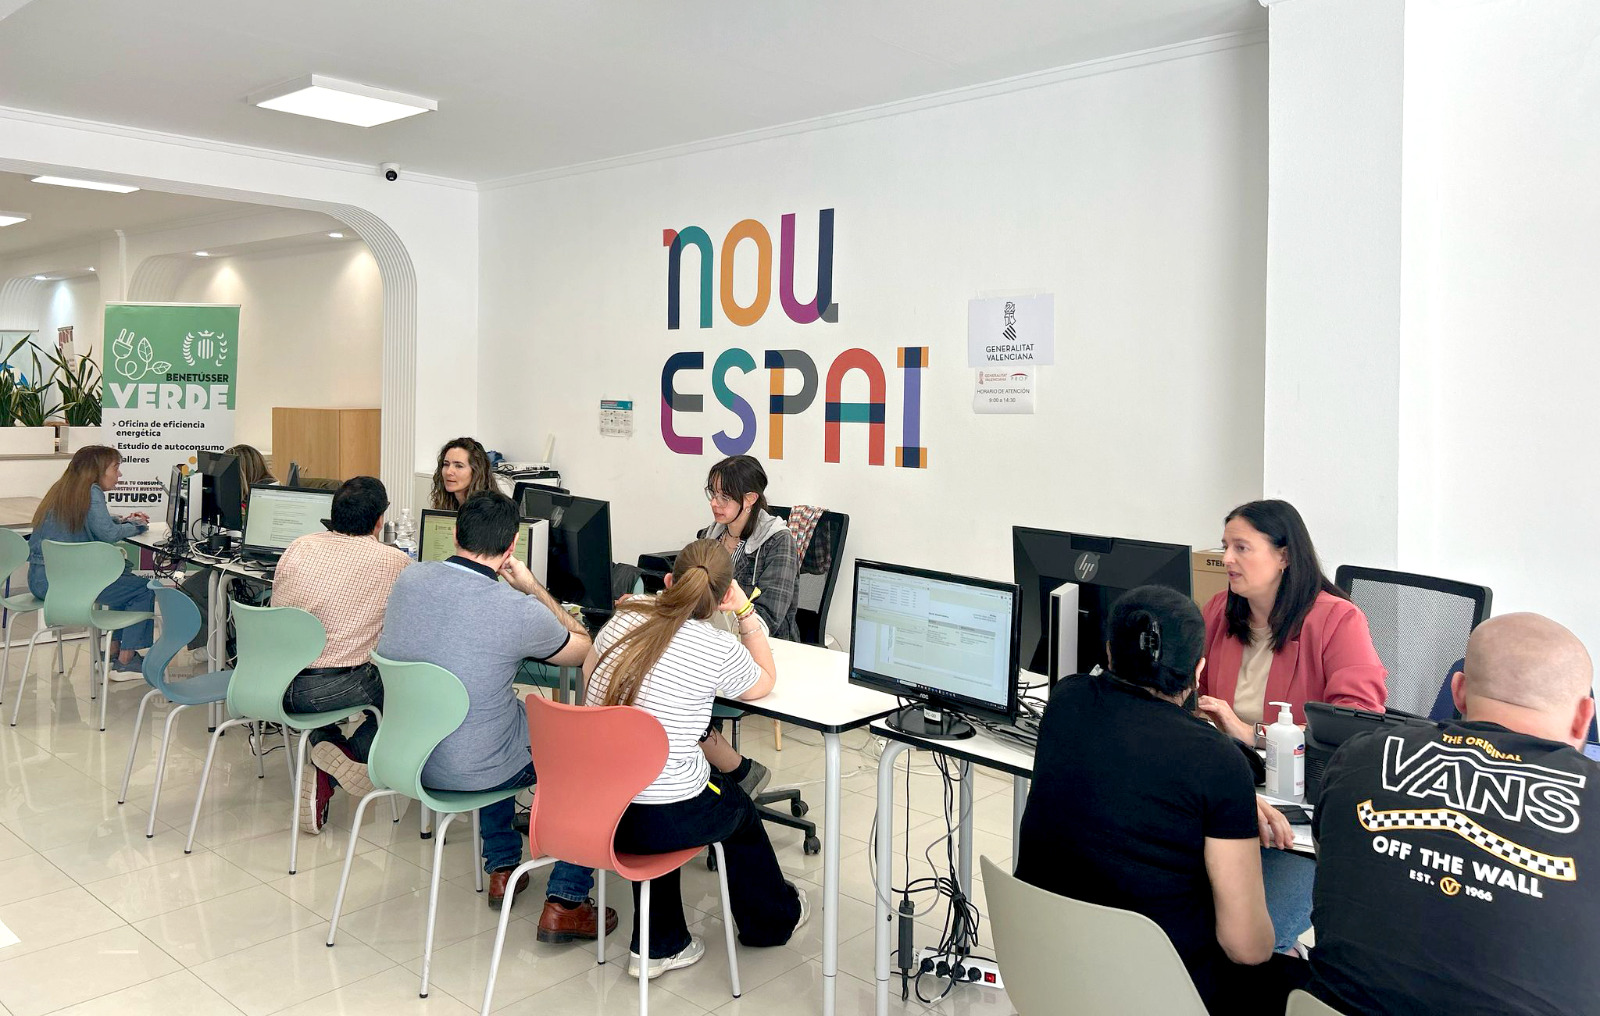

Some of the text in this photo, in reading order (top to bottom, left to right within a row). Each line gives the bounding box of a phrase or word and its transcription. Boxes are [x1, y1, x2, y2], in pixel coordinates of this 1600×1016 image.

[985, 344, 1034, 353] GENERALITAT
[986, 353, 1034, 361] VALENCIANA
[166, 371, 229, 382] BENETÚSSER
[108, 383, 229, 409] VERDE
[661, 346, 929, 468] ESPAI
[116, 429, 161, 438] energética
[118, 420, 149, 428] Oficina
[163, 420, 205, 429] eficiencia
[108, 493, 162, 502] FUTURO!
[1442, 733, 1522, 762] THE ORIGINAL
[1382, 736, 1586, 834] VANS
[1372, 836, 1543, 898] OFF THE WALL
[1409, 869, 1435, 886] EST.
[1465, 884, 1493, 902] 1966
